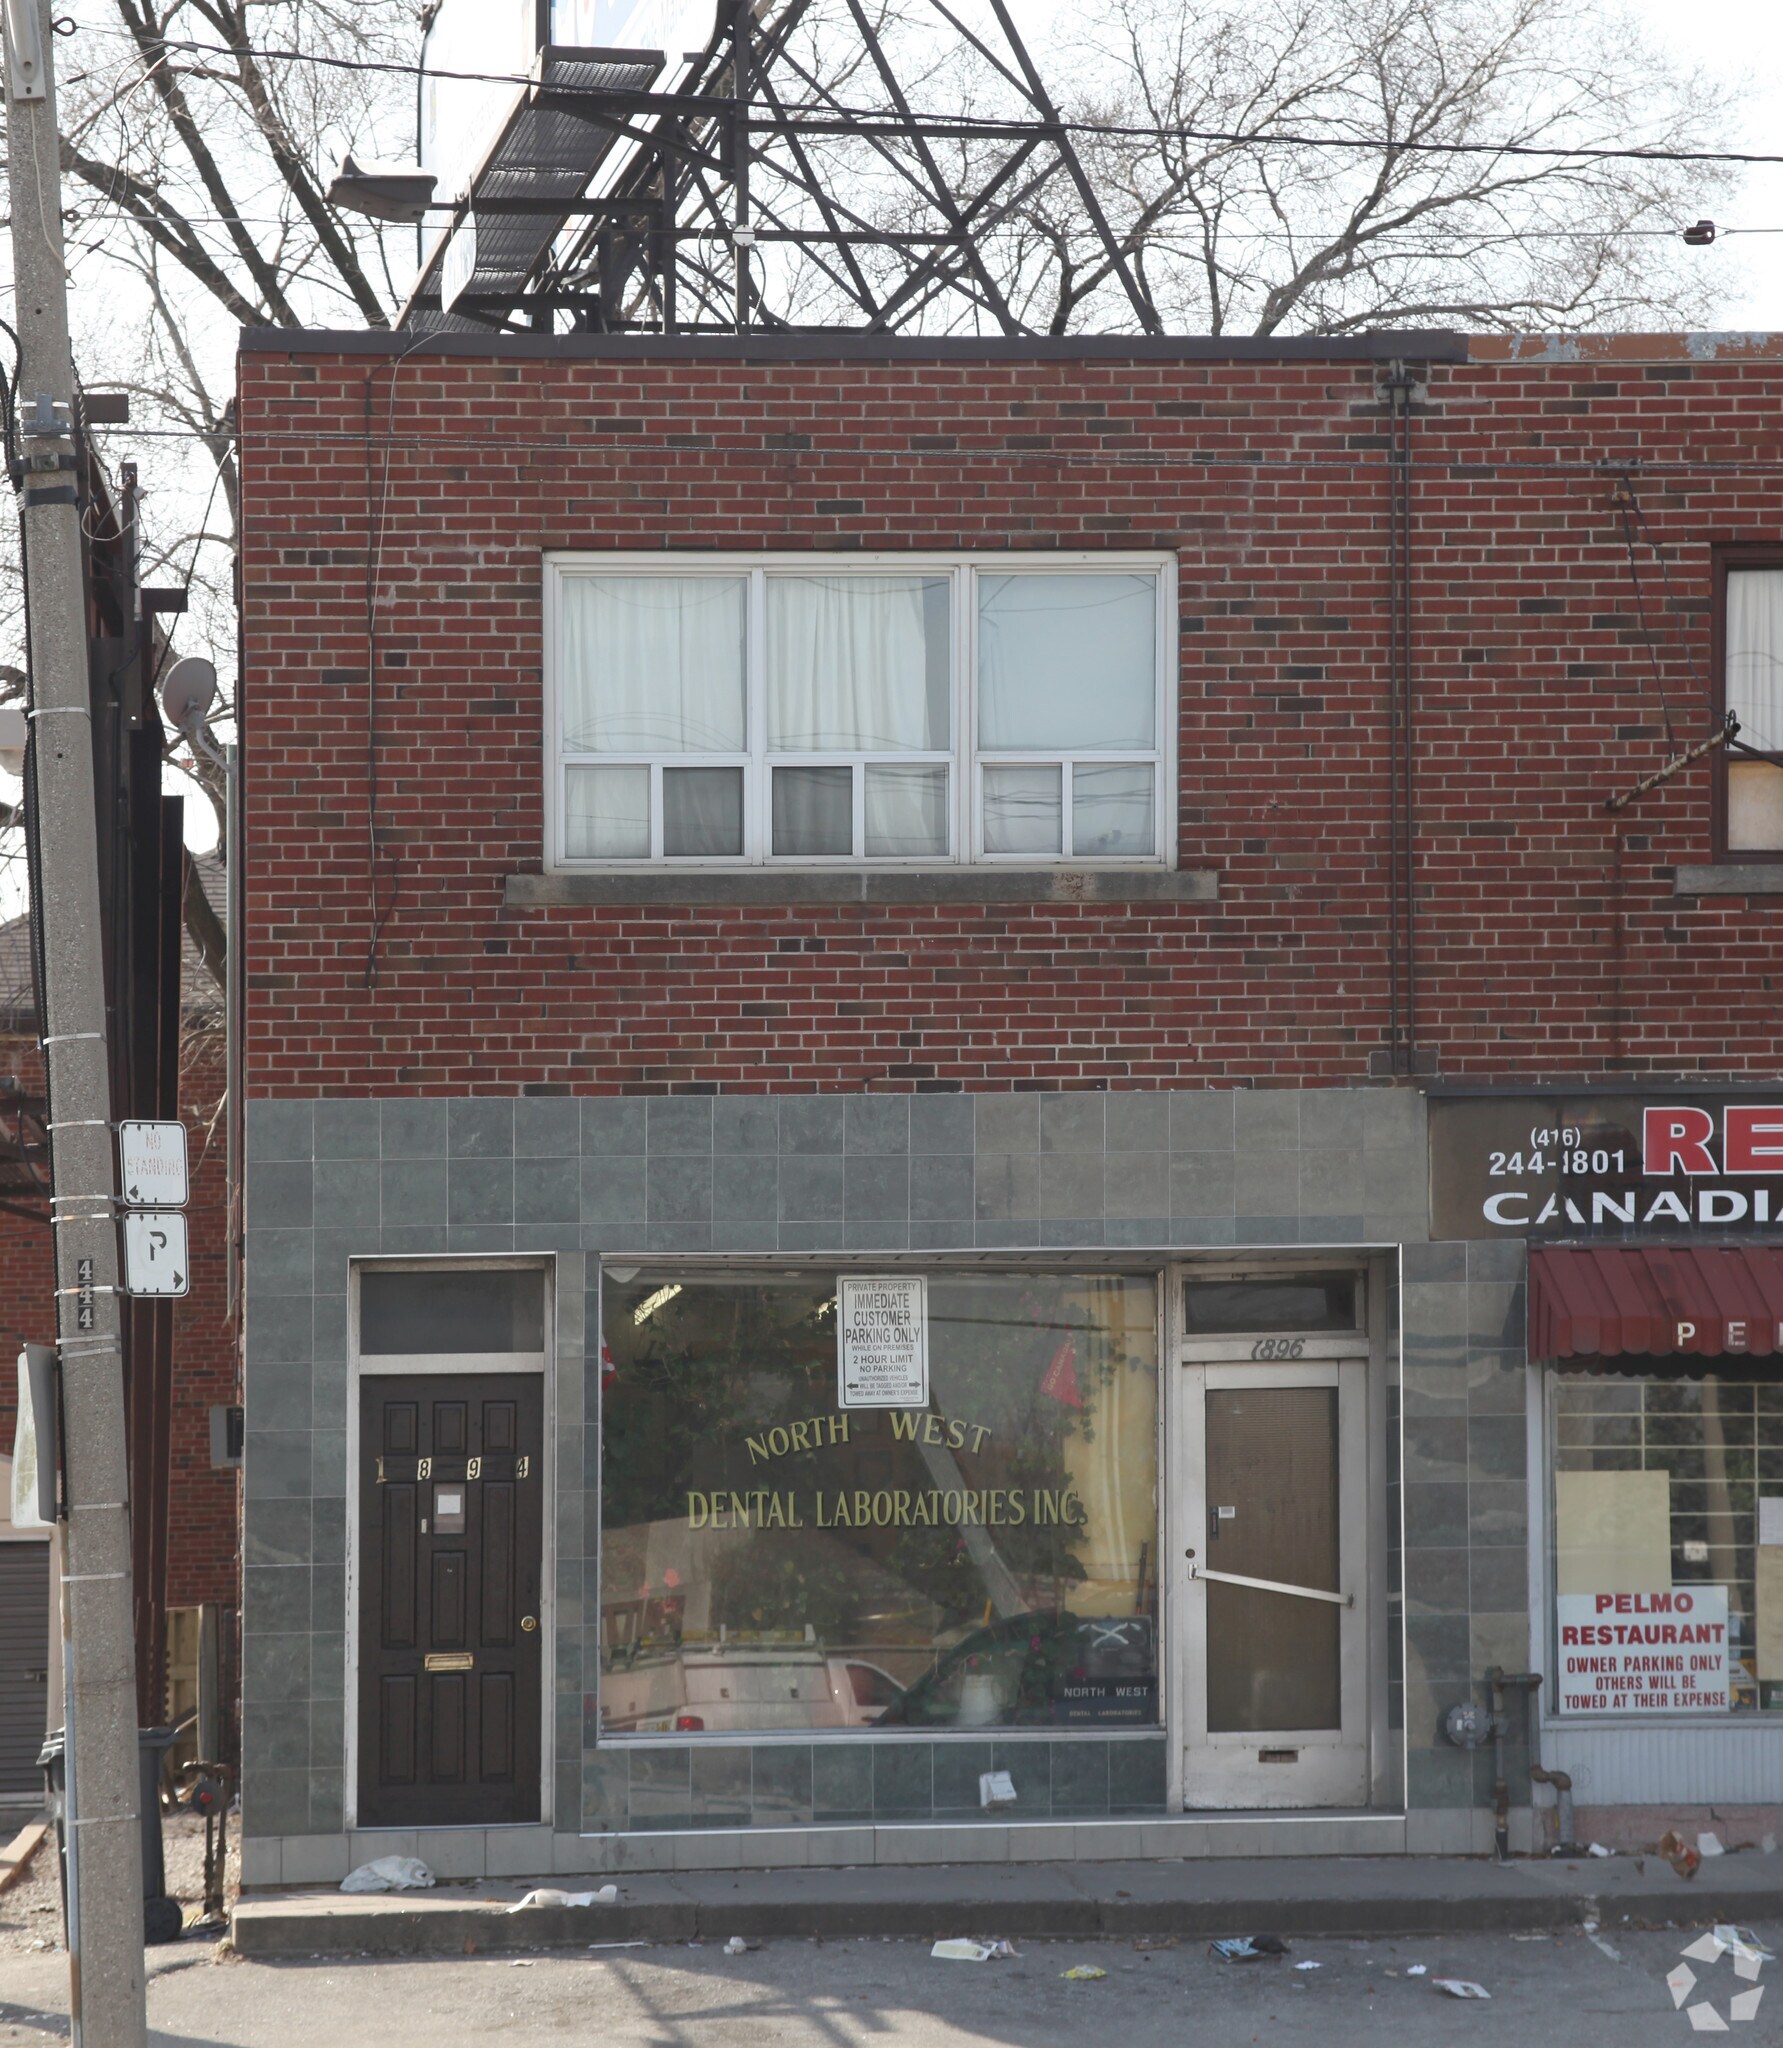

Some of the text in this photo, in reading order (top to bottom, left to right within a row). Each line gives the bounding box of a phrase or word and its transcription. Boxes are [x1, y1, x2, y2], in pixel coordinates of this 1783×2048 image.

[145, 1132, 161, 1150] NO
[1530, 1127, 1581, 1149] (416)
[128, 1158, 183, 1176] STANDING
[1489, 1149, 1624, 1176] 244-1801
[1483, 1189, 1783, 1226] CANADI
[848, 1283, 916, 1291] PRIVATE PROPERTY
[855, 1293, 909, 1309] IMMEDIATE
[854, 1310, 910, 1326] CUSTOMER
[846, 1328, 920, 1344] PARKING ONLY
[1251, 1338, 1306, 1360] 1896
[853, 1354, 913, 1364] 2 HOUR LIMIT
[860, 1365, 871, 1373] NO
[745, 1411, 992, 1465] NORTH WEST
[688, 1489, 1088, 1529] DENTAL LABORATORIES INC.
[1595, 1593, 1693, 1614] PELMO
[1562, 1624, 1725, 1646] RESTAURANT
[1567, 1655, 1722, 1673] OWNER PARKING ONLY
[1595, 1674, 1696, 1691] OTHERS WILL BE
[1064, 1687, 1148, 1697] NORTH WEST
[1565, 1691, 1726, 1709] TOWED AT THEIR EXPENSE
